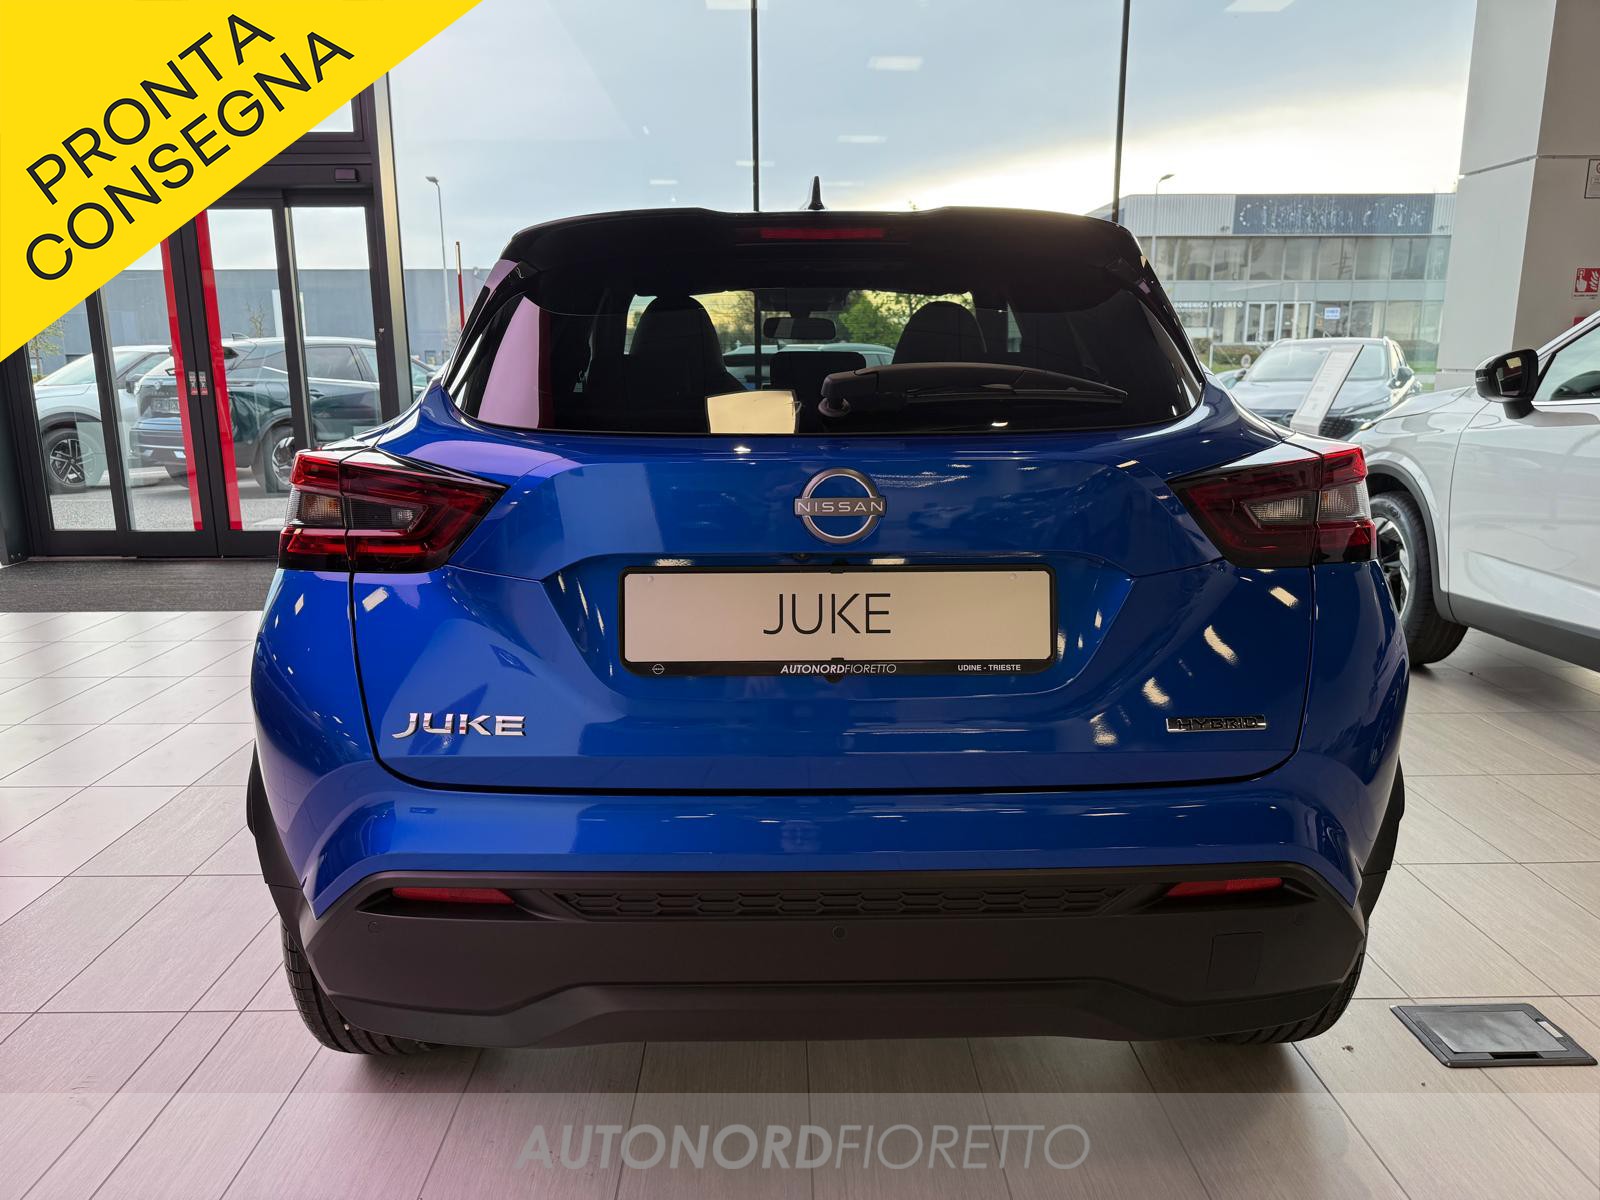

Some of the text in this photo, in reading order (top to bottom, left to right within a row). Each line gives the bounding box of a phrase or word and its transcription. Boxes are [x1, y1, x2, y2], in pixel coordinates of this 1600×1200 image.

[796, 501, 884, 513] NISSAN
[763, 593, 891, 635] JUKE
[780, 663, 897, 674] AUTONORDFIORETTO
[957, 664, 982, 672] UDINE
[988, 664, 1021, 672] TRIESTE
[391, 712, 526, 739] JUKE
[1174, 716, 1261, 730] HYBRID
